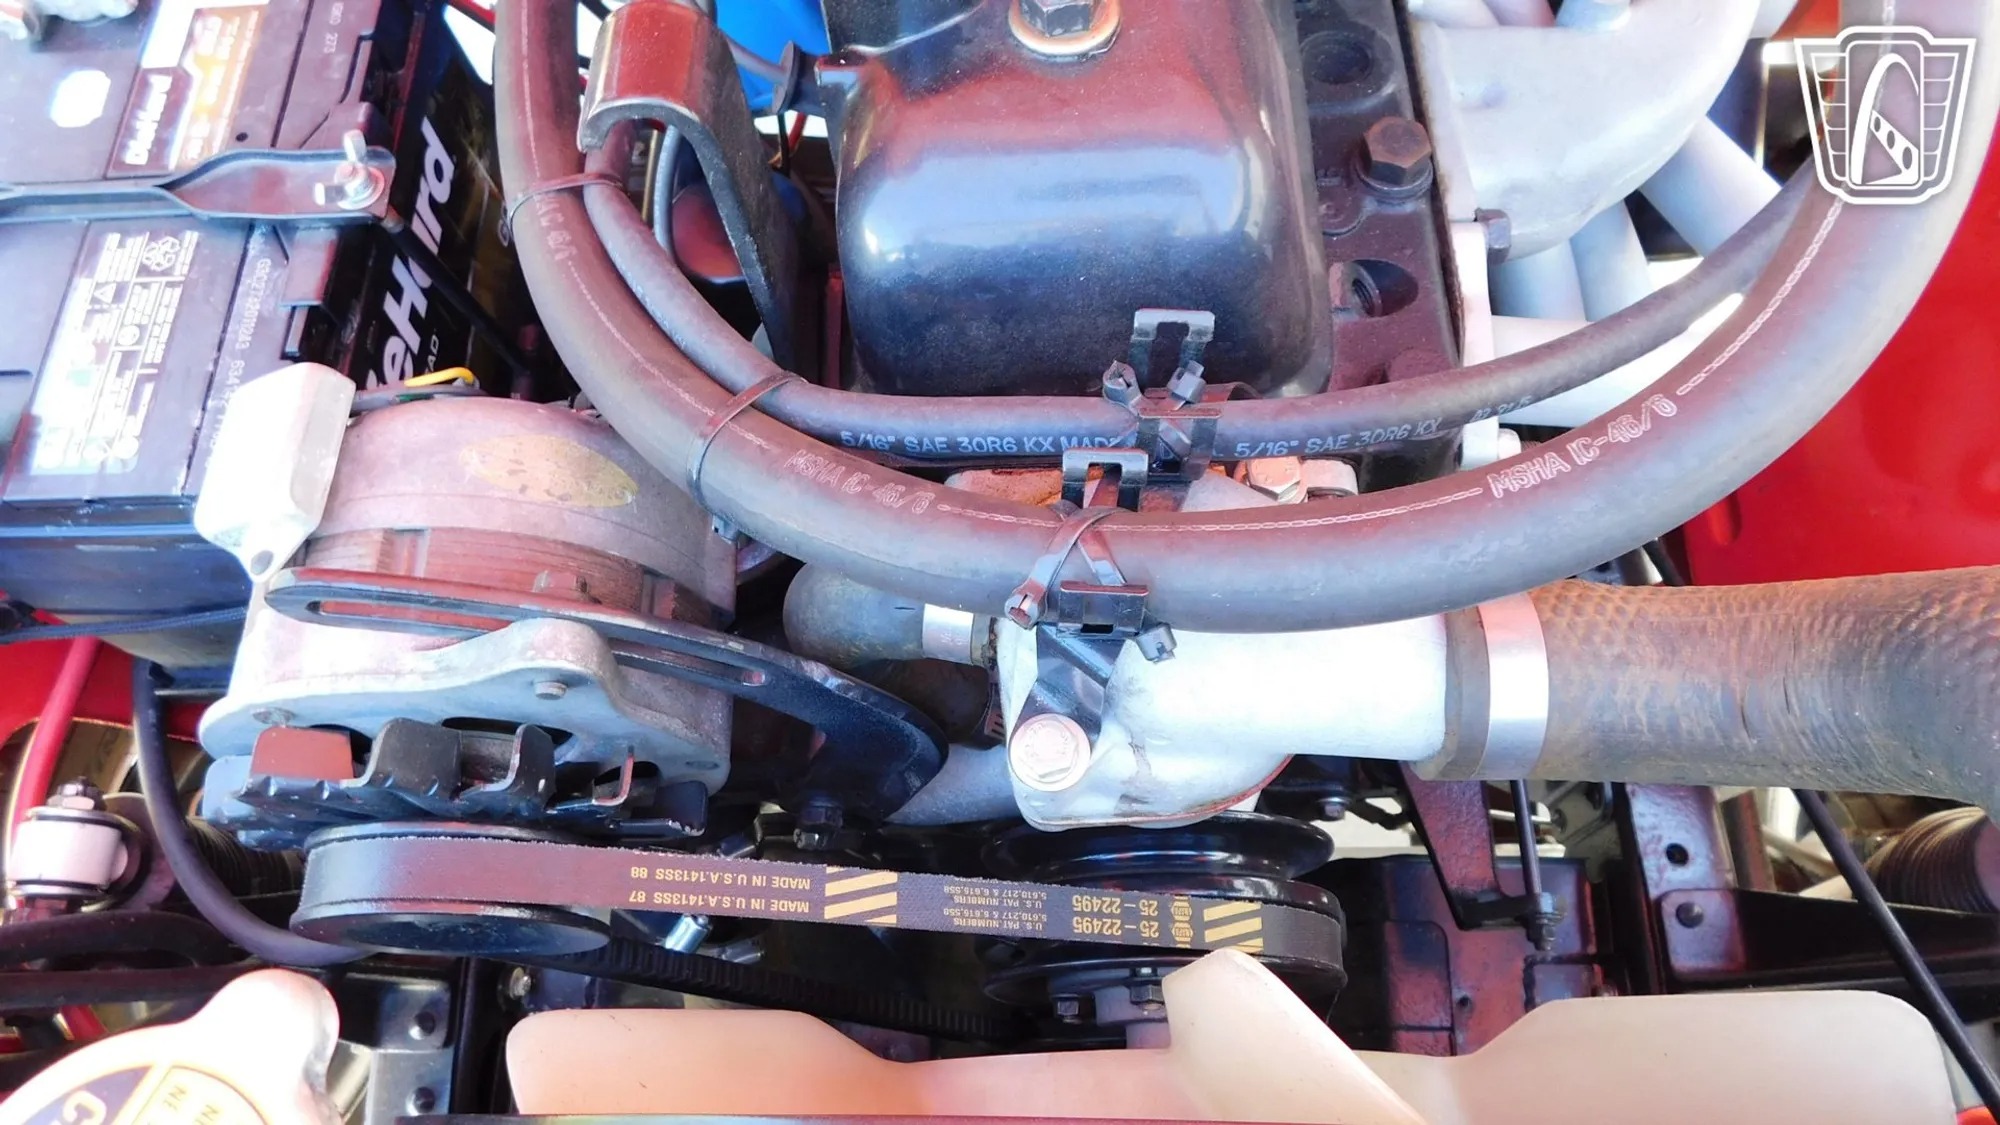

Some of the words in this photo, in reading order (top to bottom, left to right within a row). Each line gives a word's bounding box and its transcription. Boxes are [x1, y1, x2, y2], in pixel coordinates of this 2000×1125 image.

[839, 430, 896, 451] 5/16"
[903, 436, 948, 452] SAE
[956, 436, 1018, 453] 30R6
[1023, 436, 1055, 452] KX
[1234, 440, 1300, 458] 5/16"
[1305, 434, 1352, 454] SAE
[1355, 424, 1409, 446] 30R6
[1486, 451, 1571, 499] MSHA
[752, 875, 766, 887] IN
[772, 876, 811, 889] MADE
[629, 891, 646, 903] 87
[751, 898, 765, 910] IN
[771, 899, 809, 913] MADE
